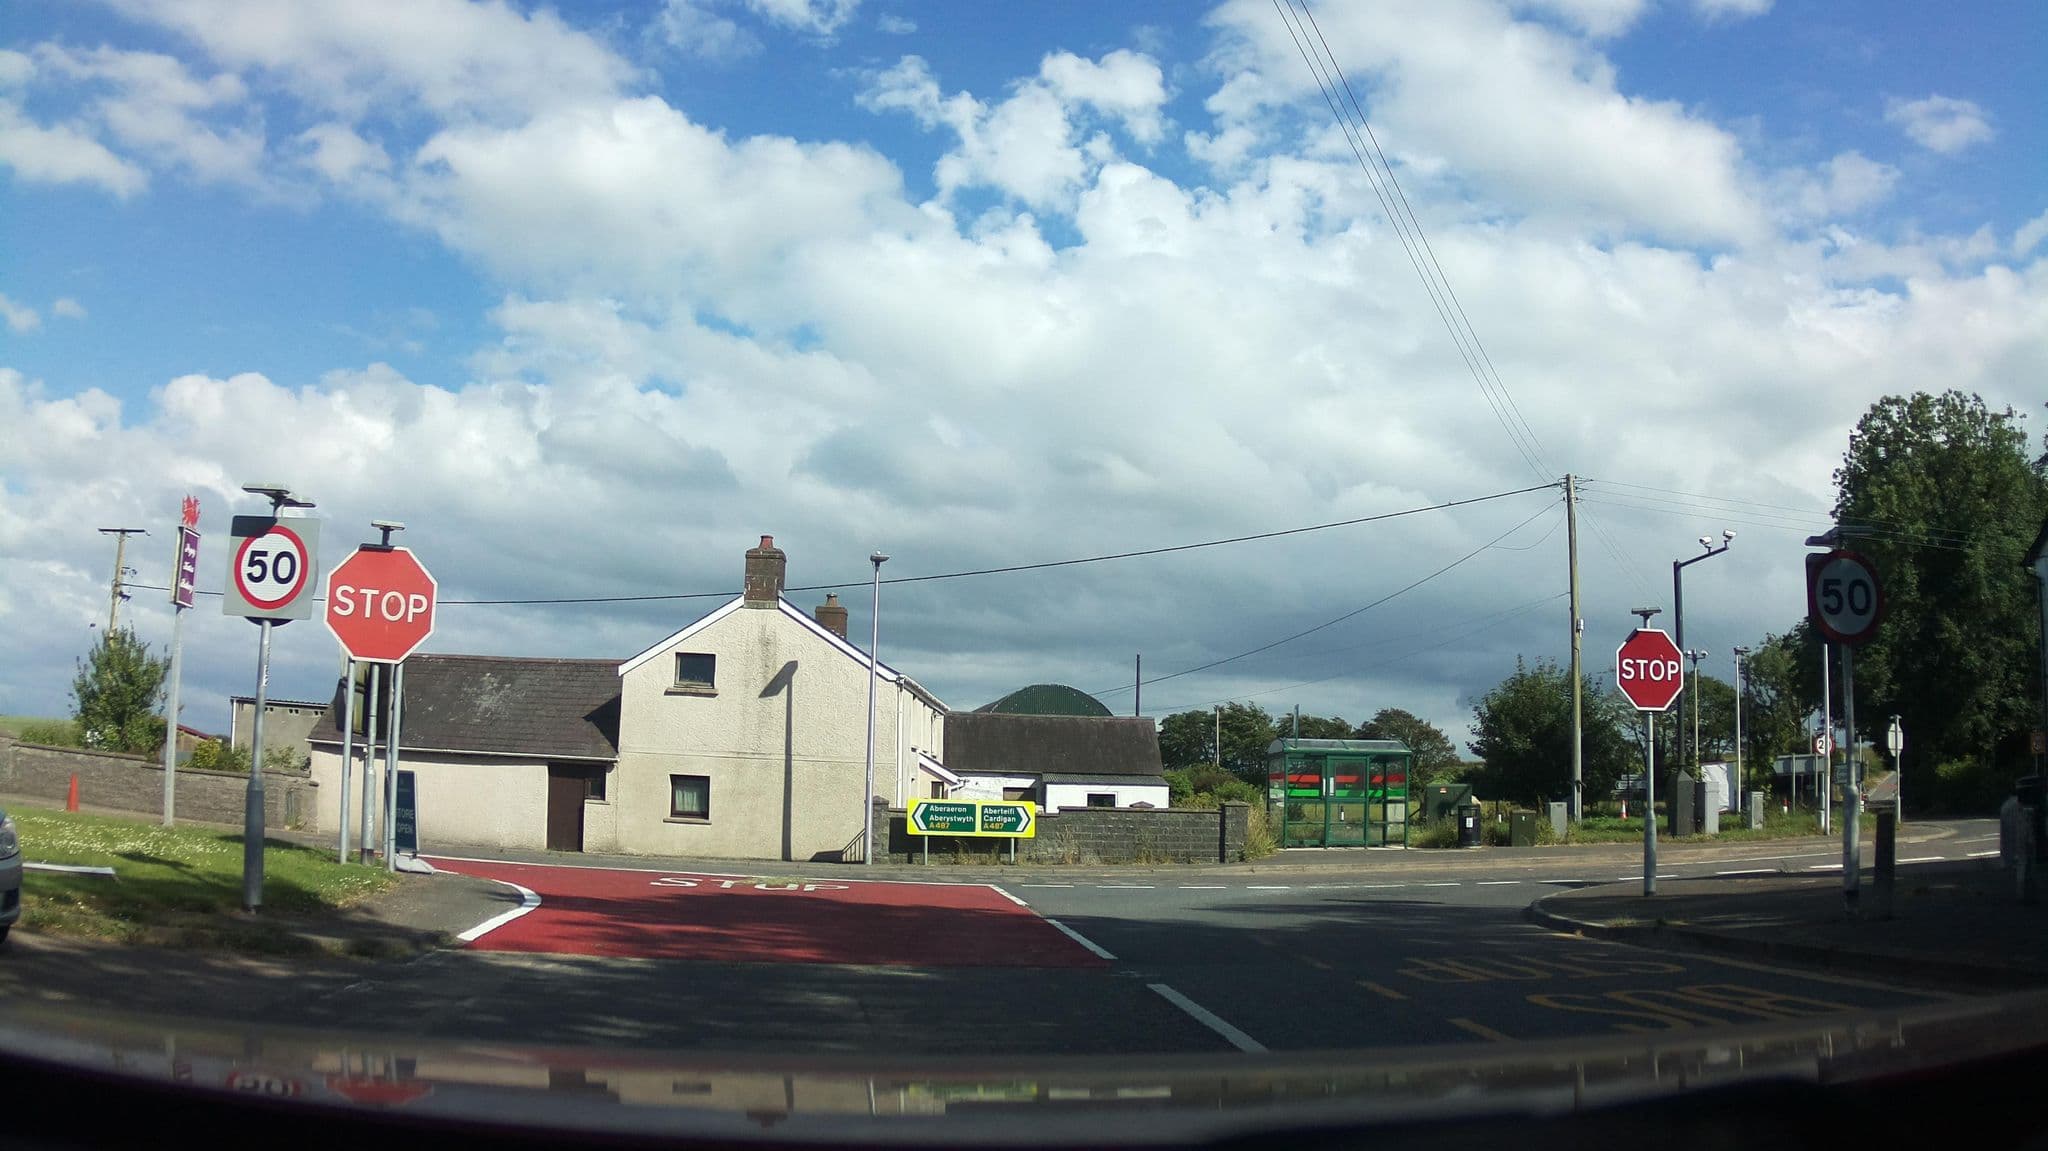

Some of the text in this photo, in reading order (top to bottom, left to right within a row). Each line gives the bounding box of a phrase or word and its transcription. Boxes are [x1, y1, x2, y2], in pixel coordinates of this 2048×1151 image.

[246, 551, 297, 584] 50
[333, 585, 428, 623] STOP
[1823, 578, 1871, 616] 50
[1621, 658, 1680, 681] STOP
[396, 807, 414, 819] TORE
[929, 815, 974, 823] Aberystwyth
[983, 815, 1016, 824] Cardigan
